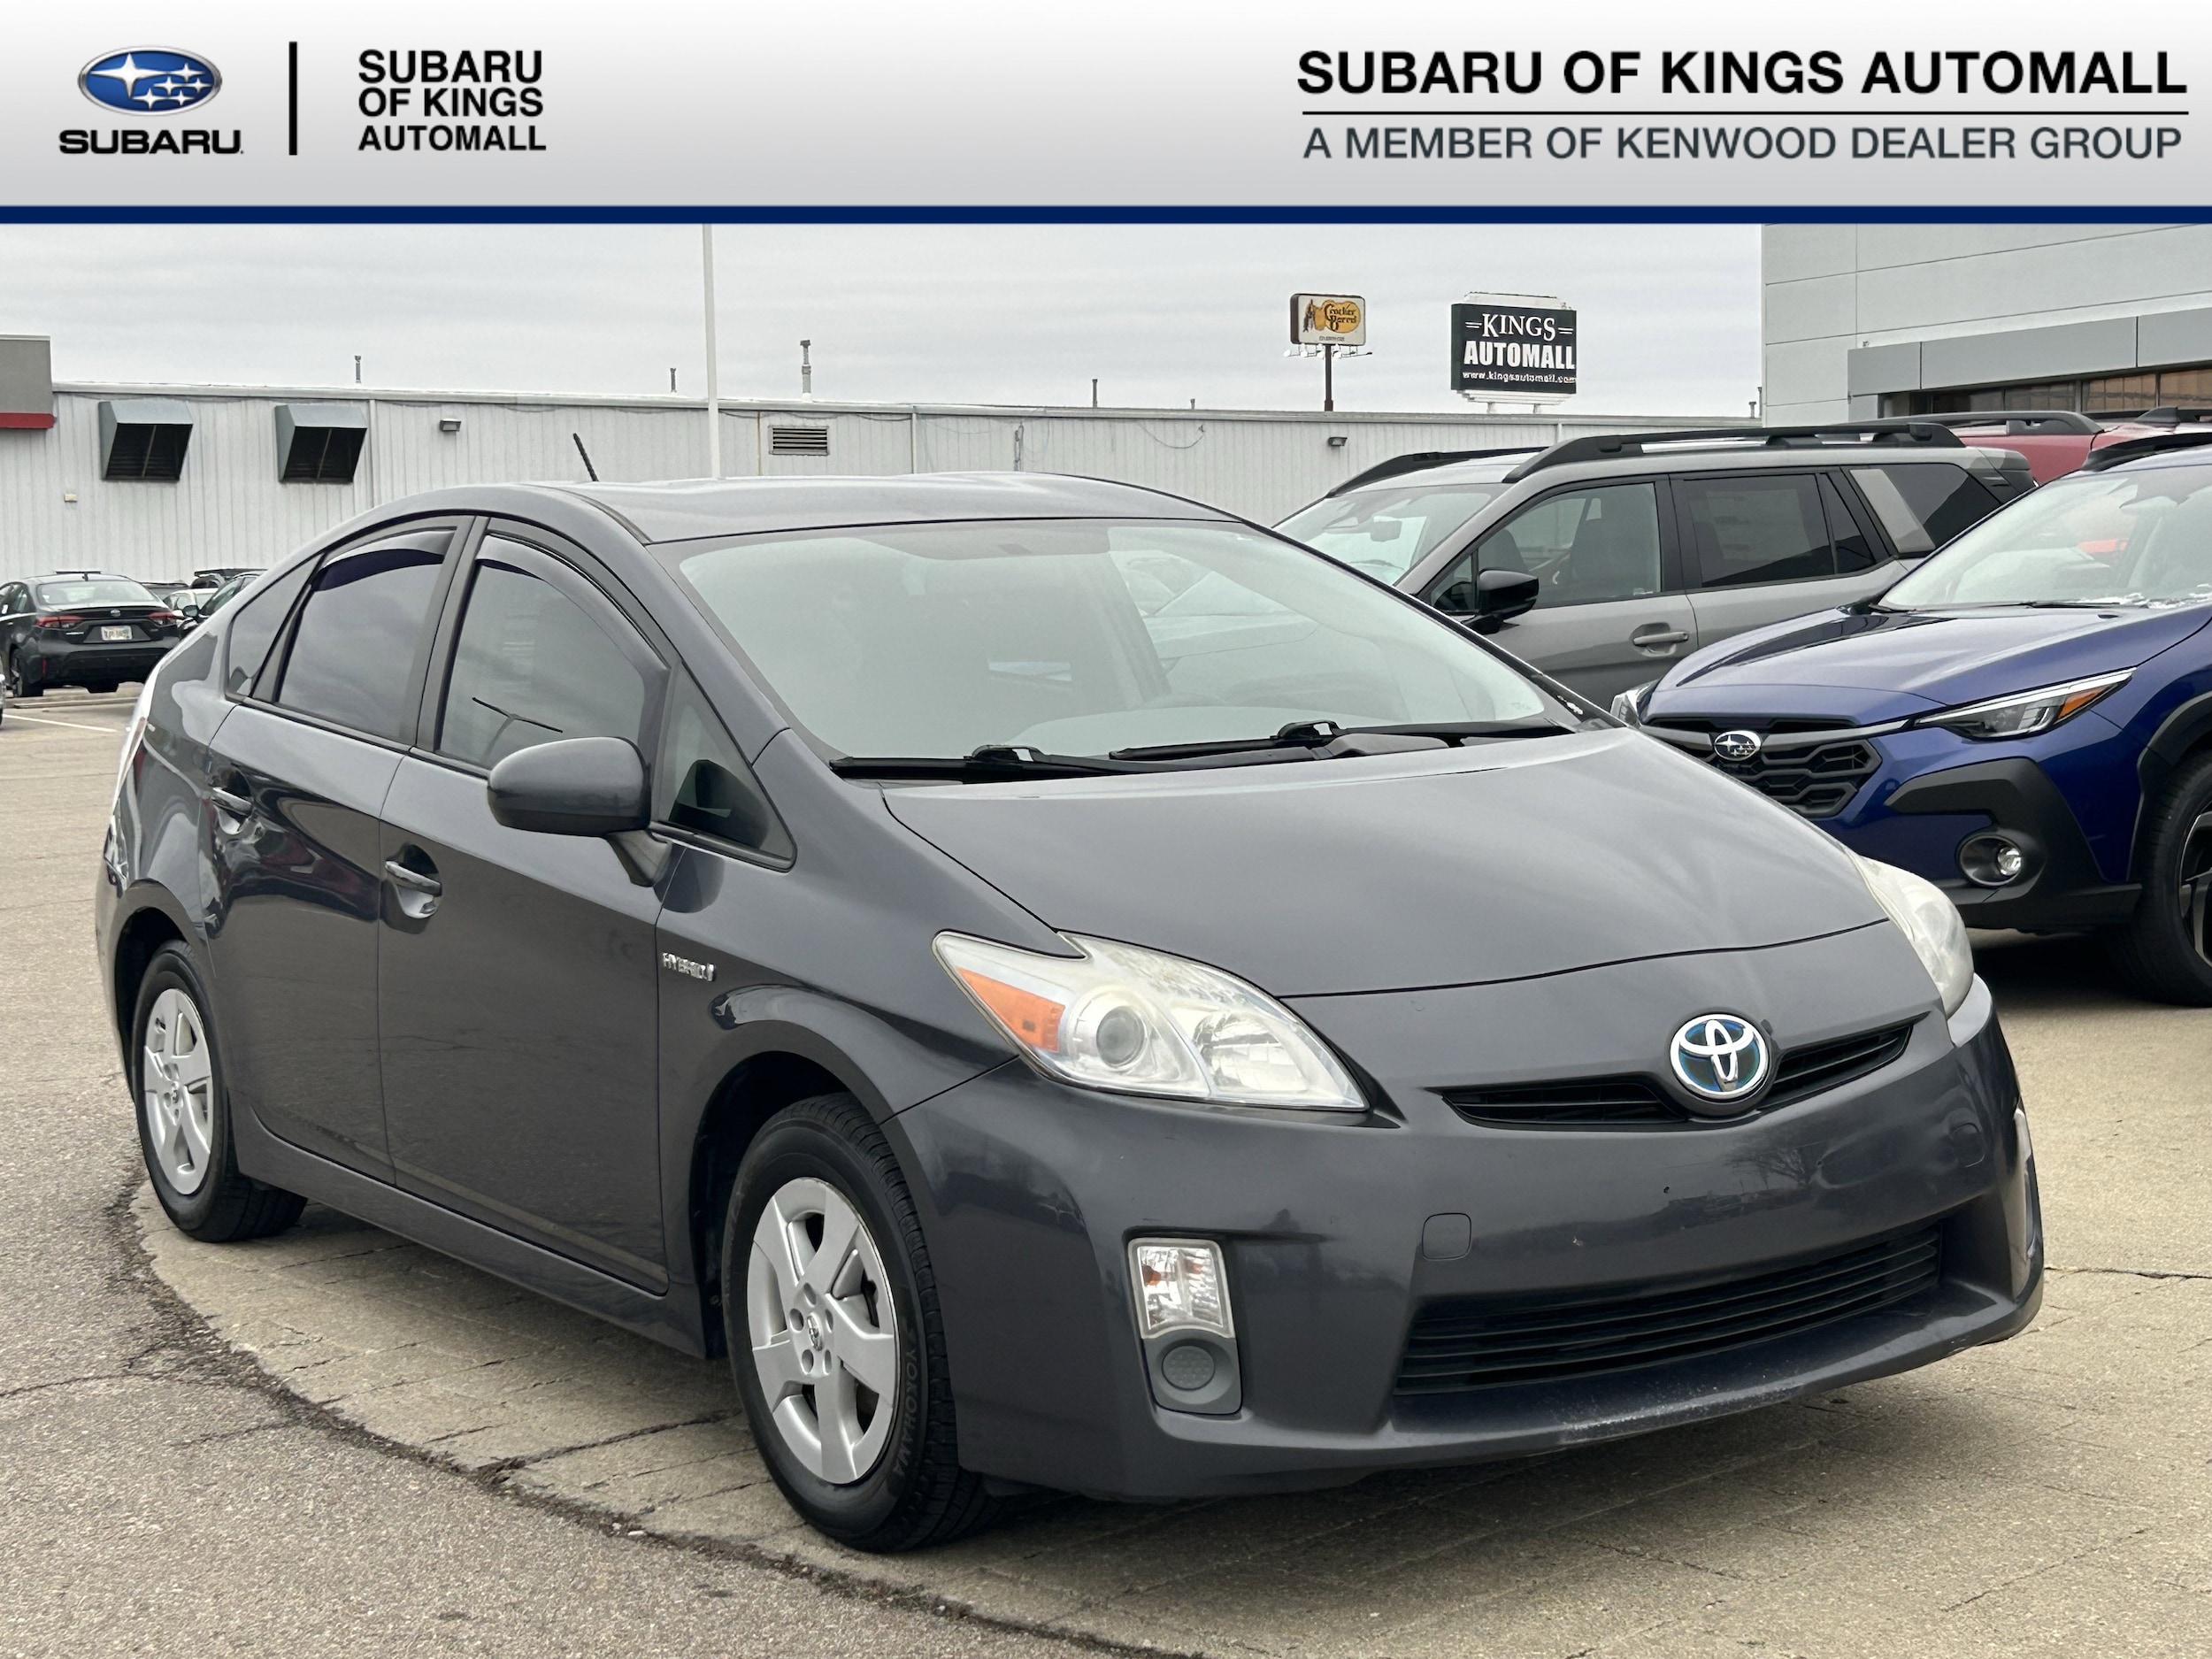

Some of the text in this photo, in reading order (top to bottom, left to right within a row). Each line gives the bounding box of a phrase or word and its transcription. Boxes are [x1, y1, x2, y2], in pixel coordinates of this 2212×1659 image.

[1482, 313, 1555, 341] KINGS
[1463, 340, 1575, 369] AUTOMALL
[1462, 371, 1576, 384] www.kingsautomall.com
[893, 1349, 918, 1477] YOKOHAMA
